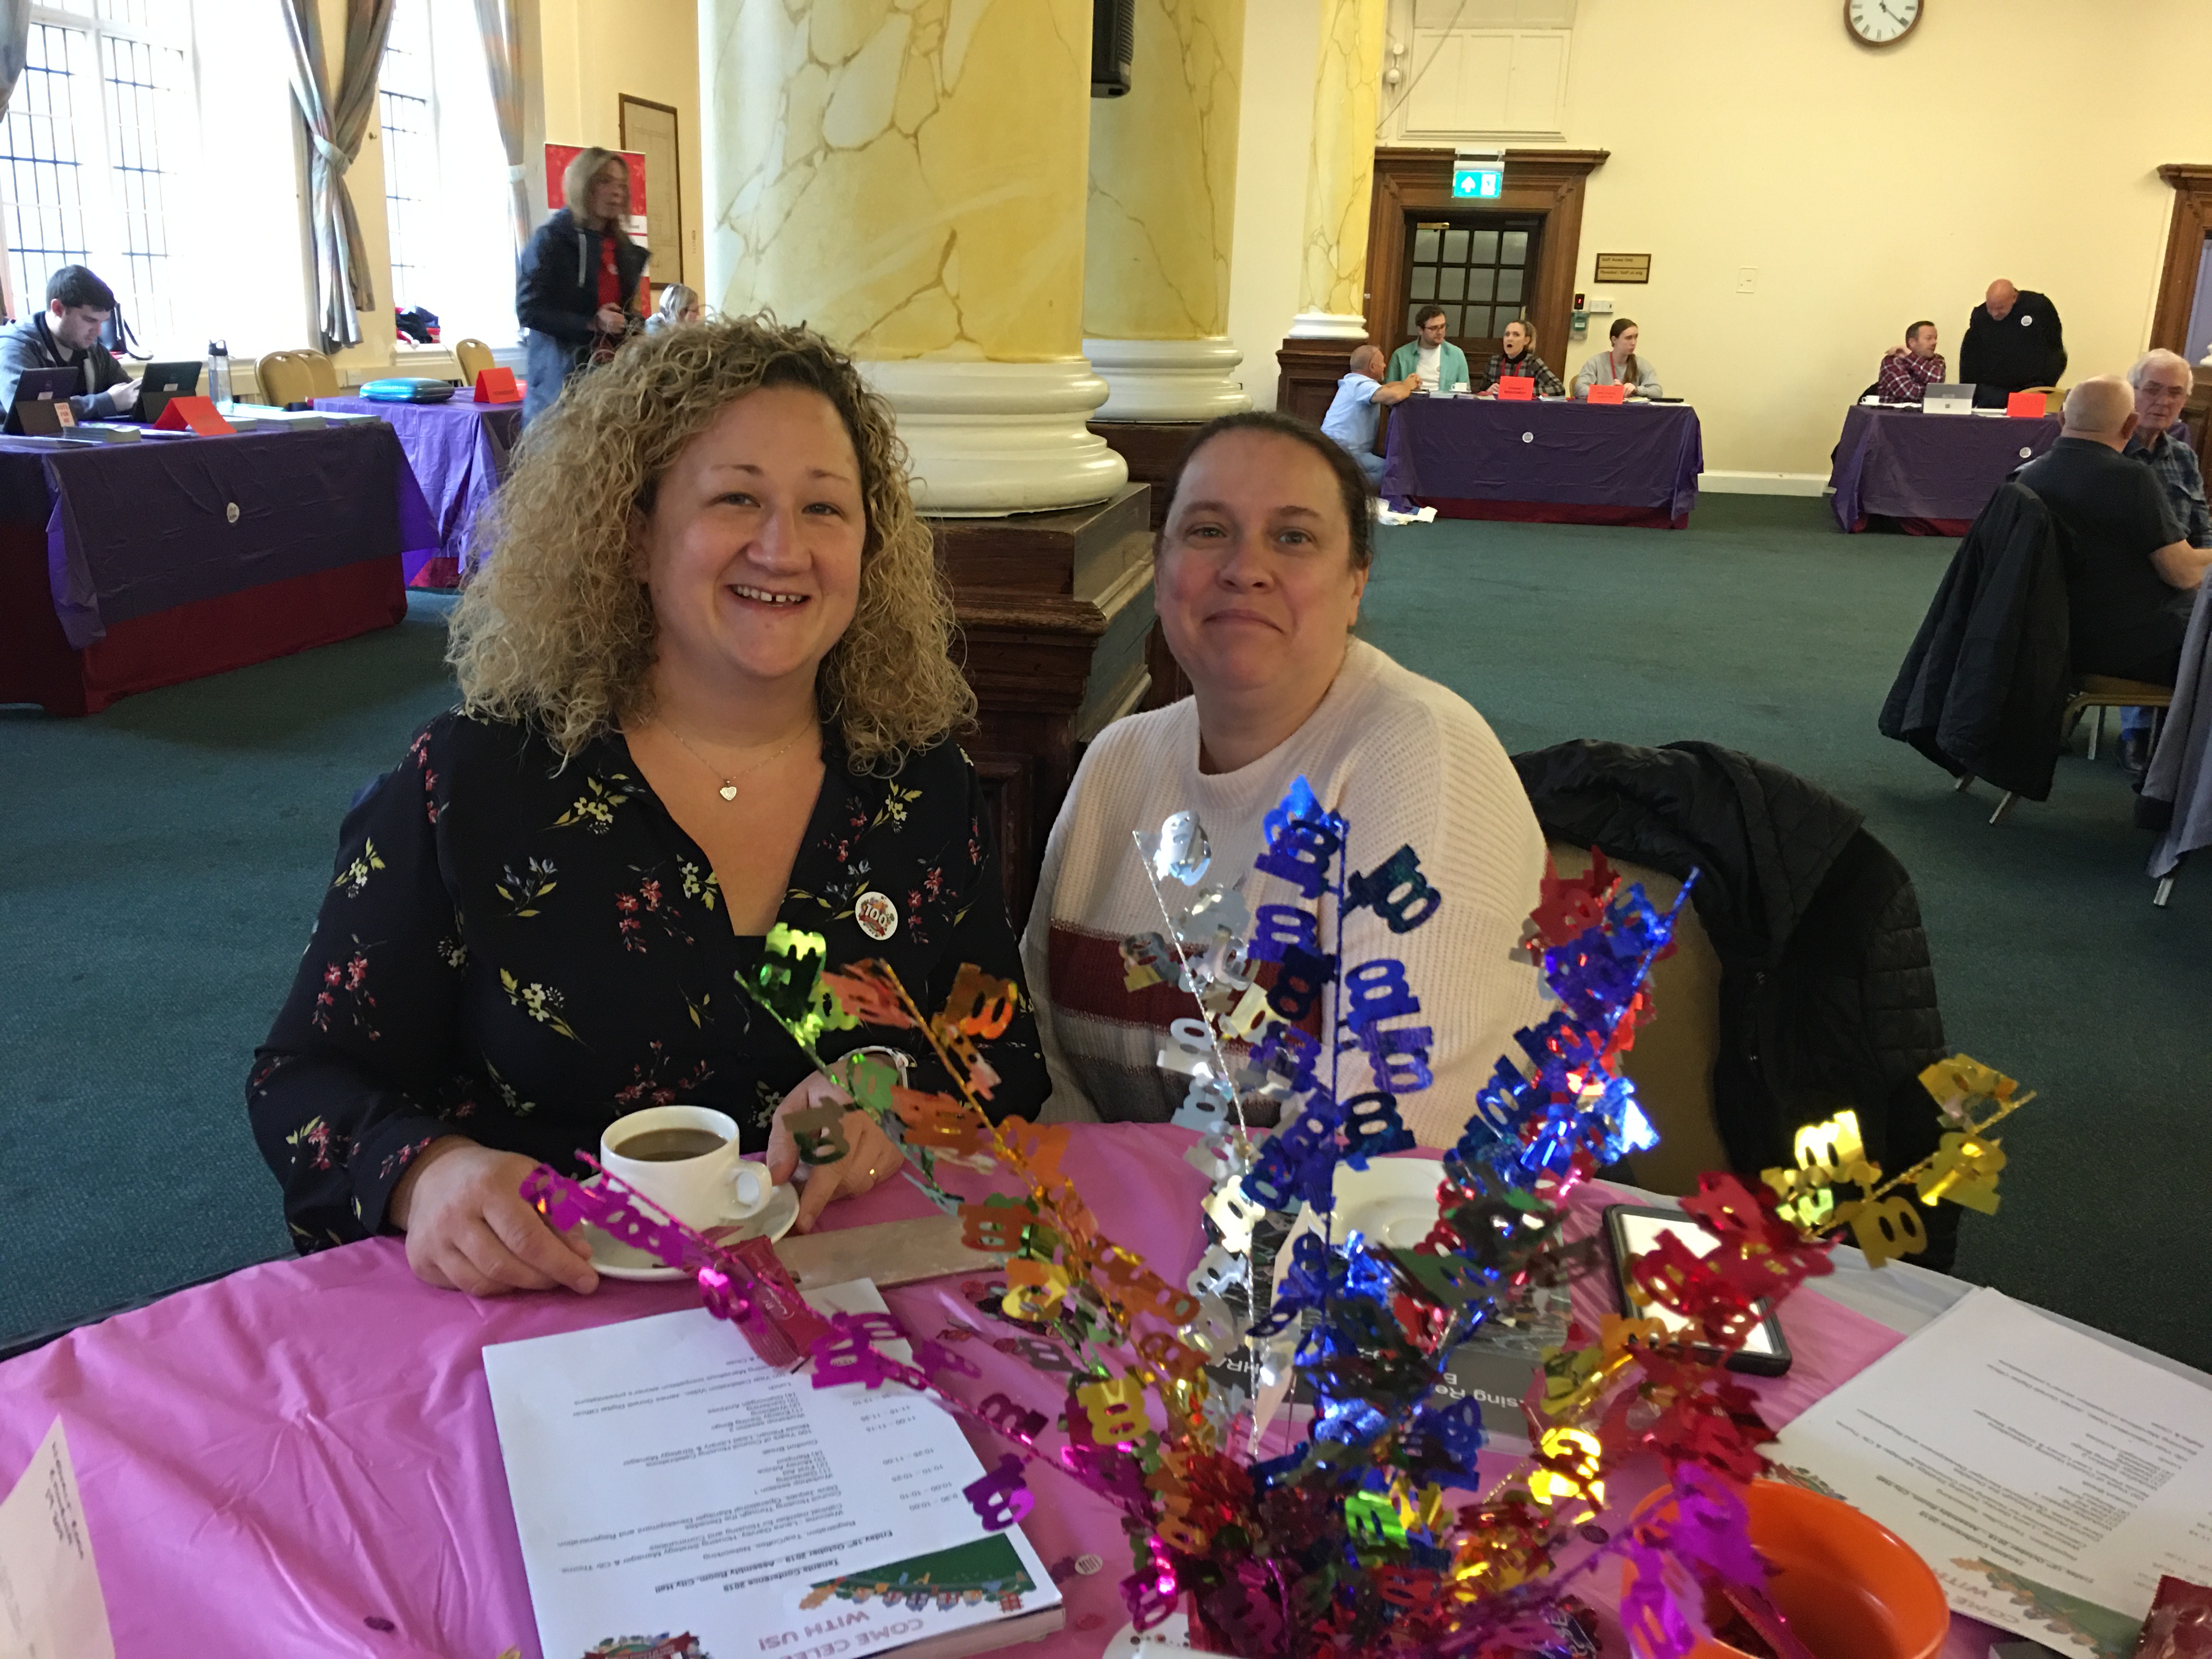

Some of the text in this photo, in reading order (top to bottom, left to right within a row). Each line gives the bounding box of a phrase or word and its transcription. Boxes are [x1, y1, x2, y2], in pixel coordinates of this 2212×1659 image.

[865, 904, 888, 928] 100
[865, 1530, 893, 1542] Friday
[808, 1542, 844, 1556] October
[785, 1551, 806, 1562] 2019
[730, 1560, 775, 1575] Assembly
[723, 1558, 839, 1592] Tenants Conference 2019
[654, 1583, 673, 1593] Hall
[675, 1578, 695, 1587] City
[758, 1610, 870, 1651] WITH US!
[854, 1618, 923, 1646] COME
